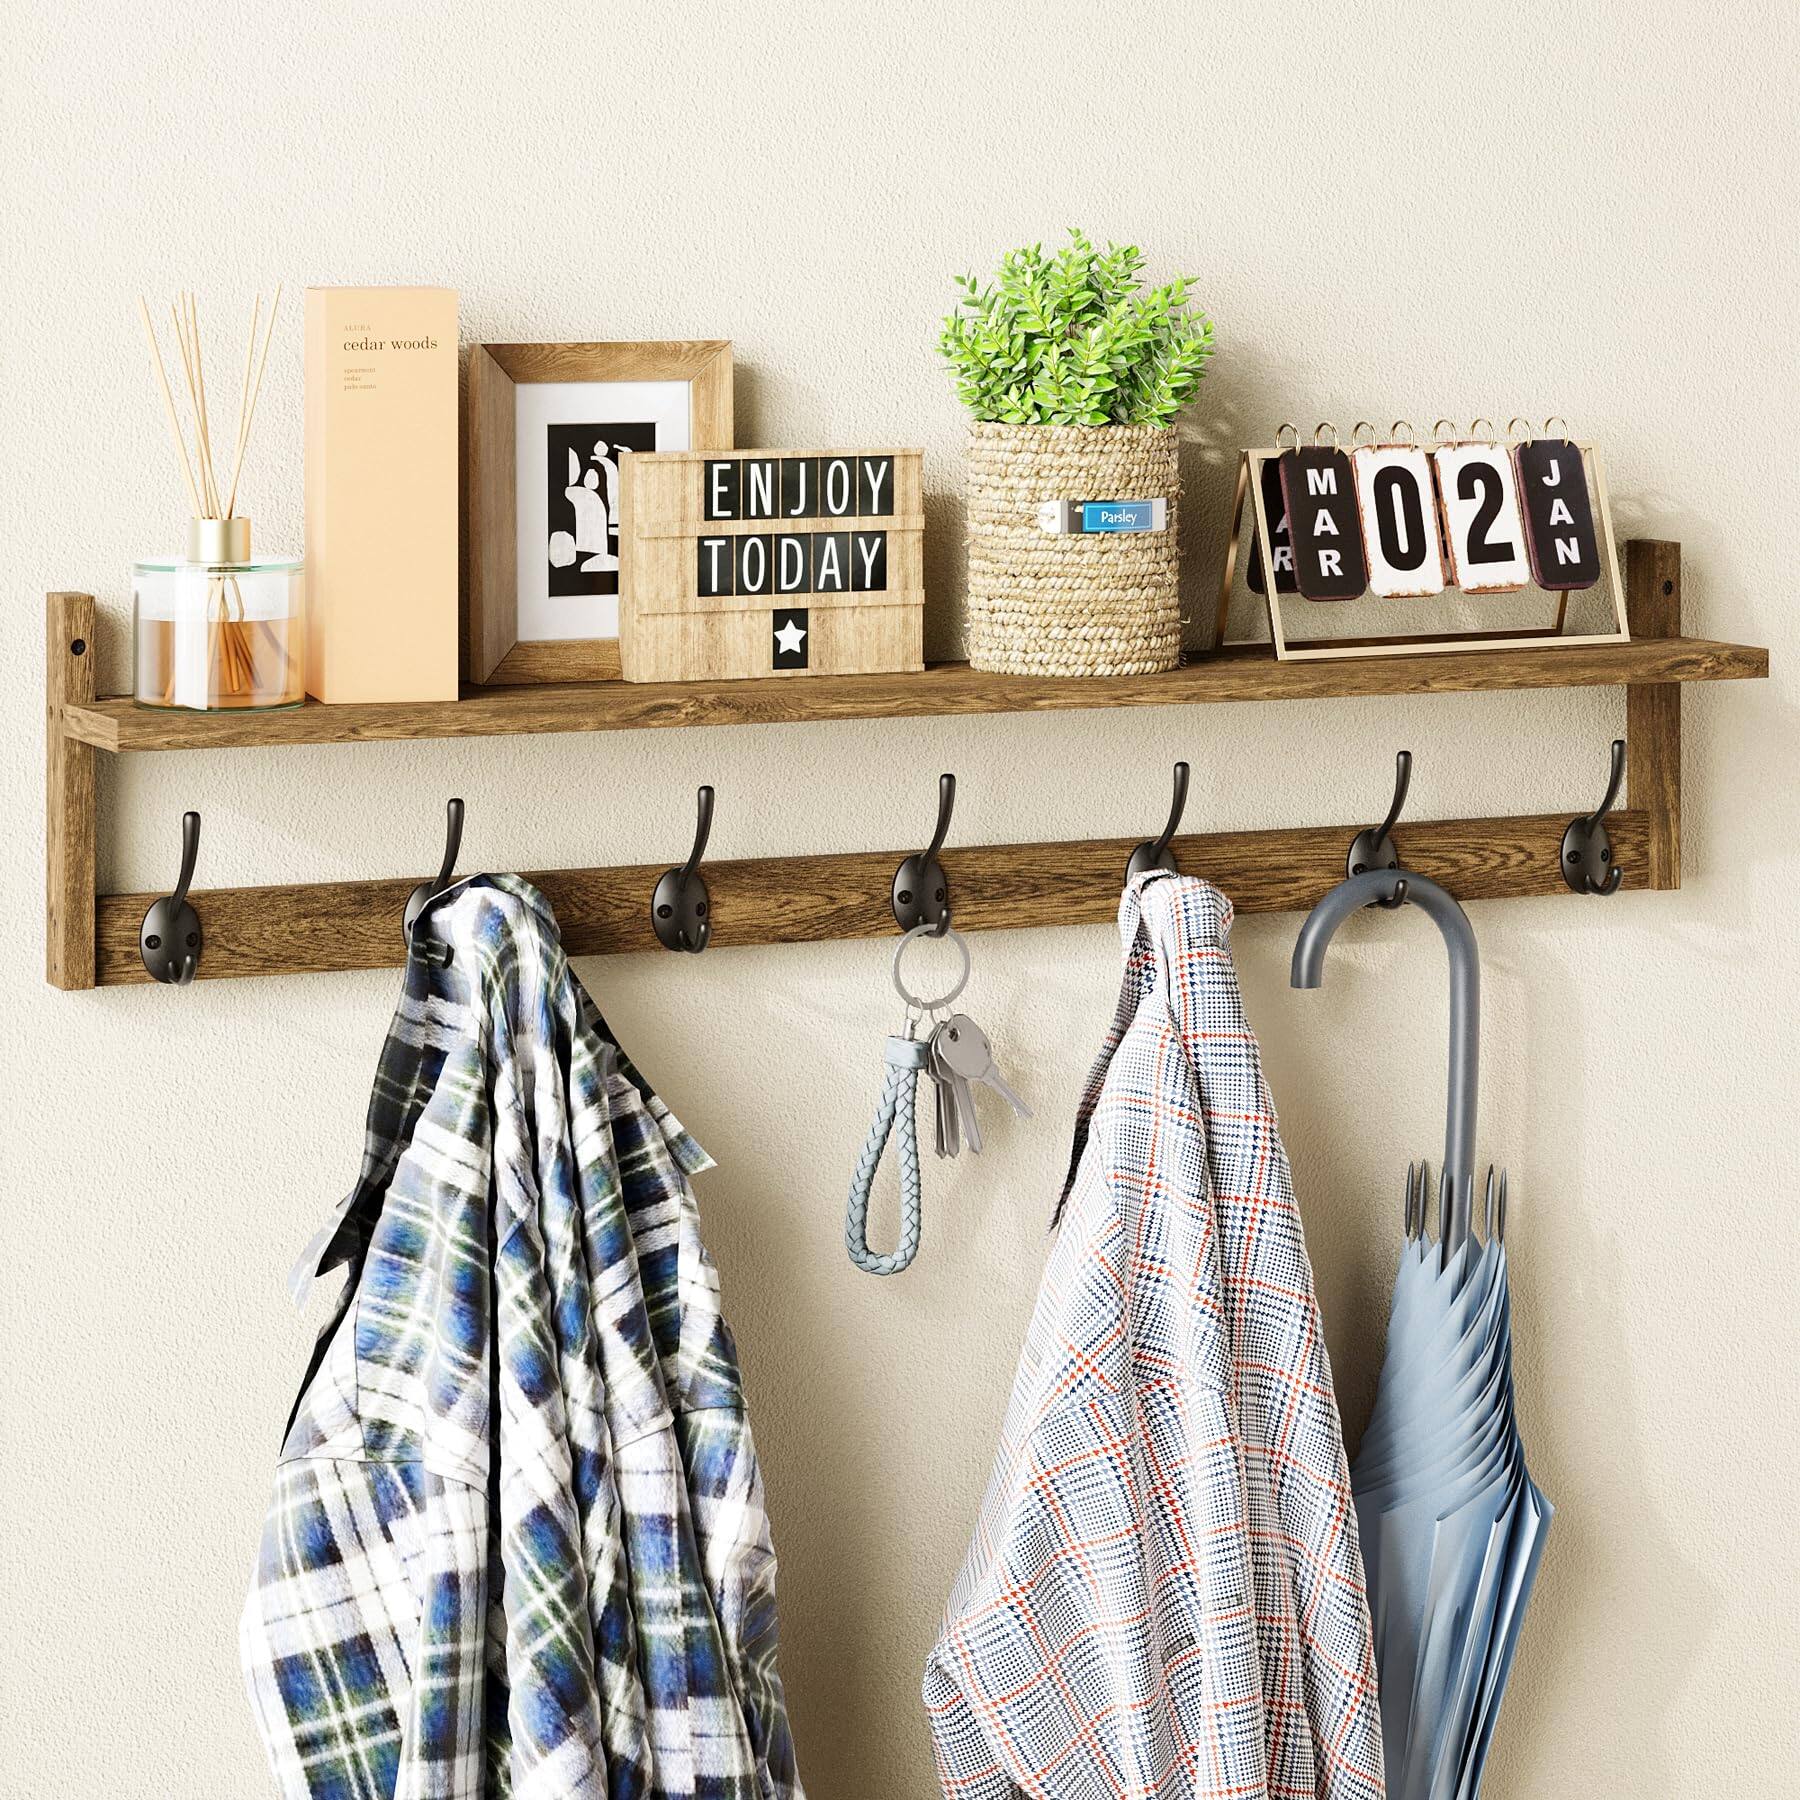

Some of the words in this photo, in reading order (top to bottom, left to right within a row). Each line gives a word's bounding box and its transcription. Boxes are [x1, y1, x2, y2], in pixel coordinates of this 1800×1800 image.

[343, 336, 386, 351] cedar
[391, 335, 438, 350] woods
[712, 460, 888, 517] ENJOY
[1542, 459, 1581, 566] JAN
[1101, 508, 1137, 526] Parsley
[1306, 467, 1344, 577] MAR
[703, 537, 881, 592] TODAY
